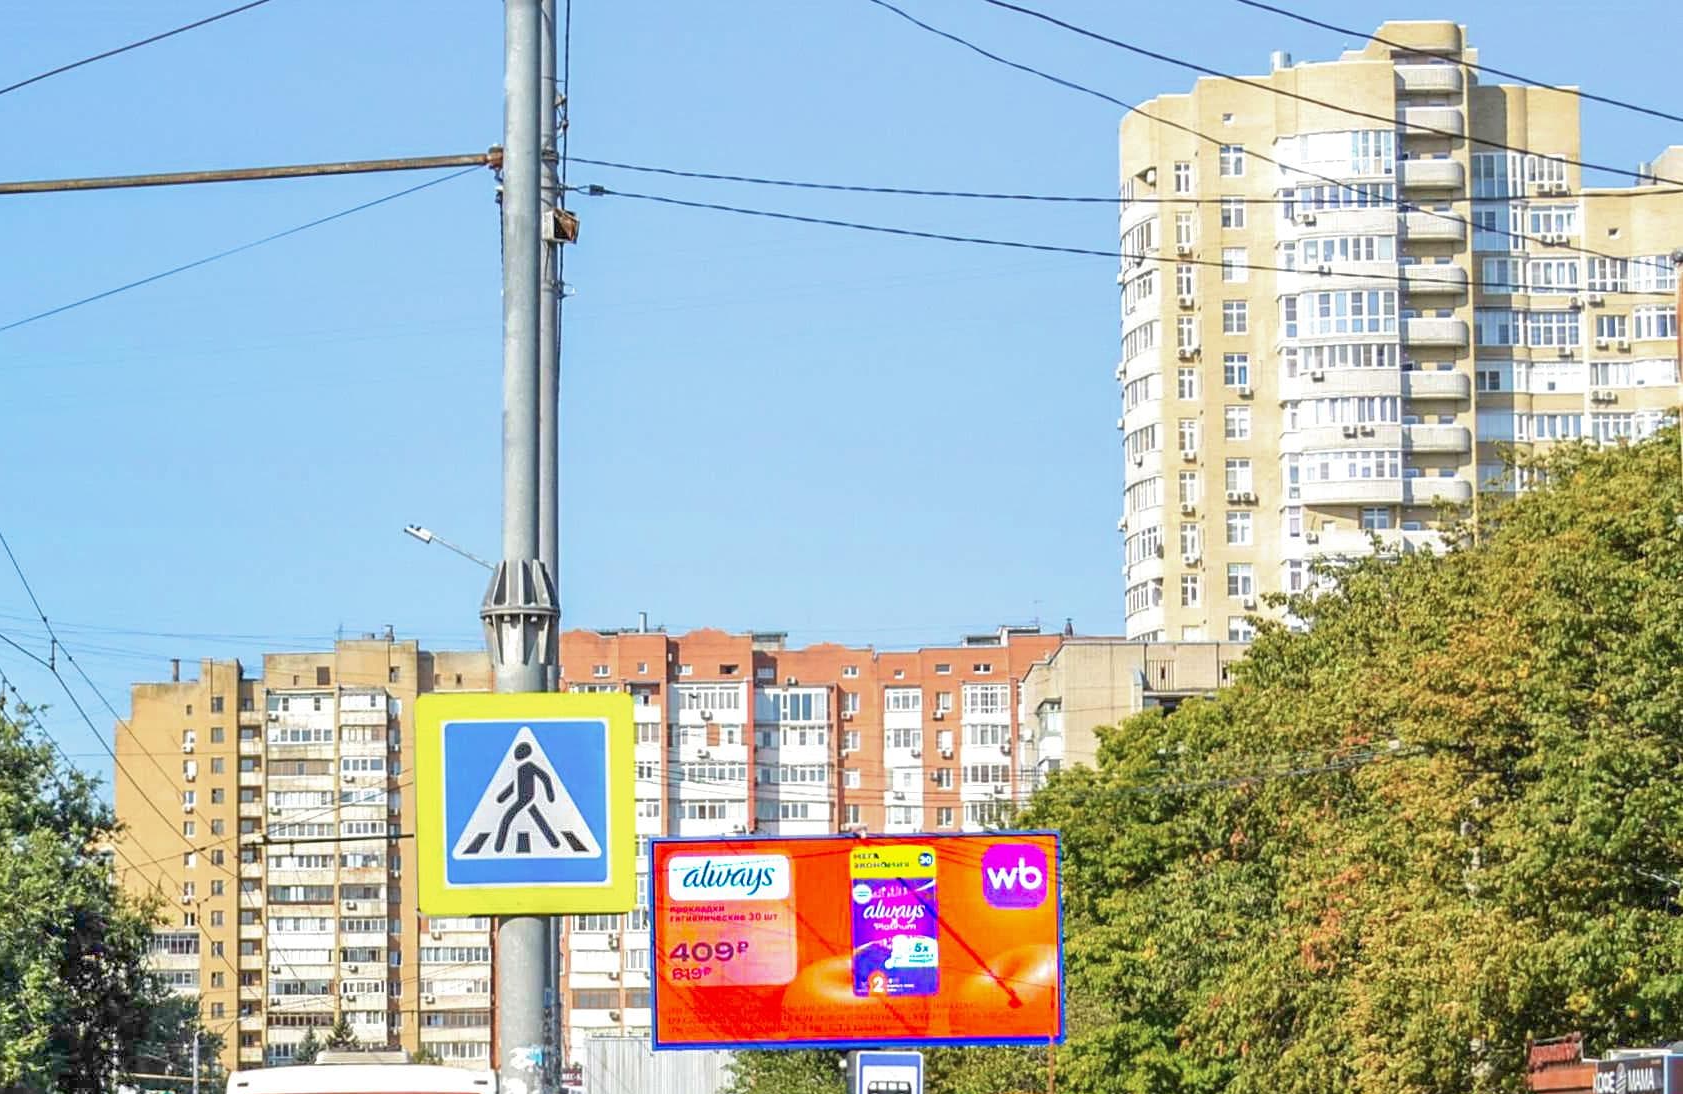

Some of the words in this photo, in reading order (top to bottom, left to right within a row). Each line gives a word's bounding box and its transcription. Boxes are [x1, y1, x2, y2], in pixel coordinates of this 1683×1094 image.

[919, 856, 932, 865] 30
[986, 857, 1042, 889] wb
[682, 860, 775, 895] always
[748, 912, 761, 921] 30
[763, 913, 778, 921] шт
[863, 899, 926, 924] always
[873, 976, 885, 992] 2
[1627, 1067, 1655, 1092] МАМА
